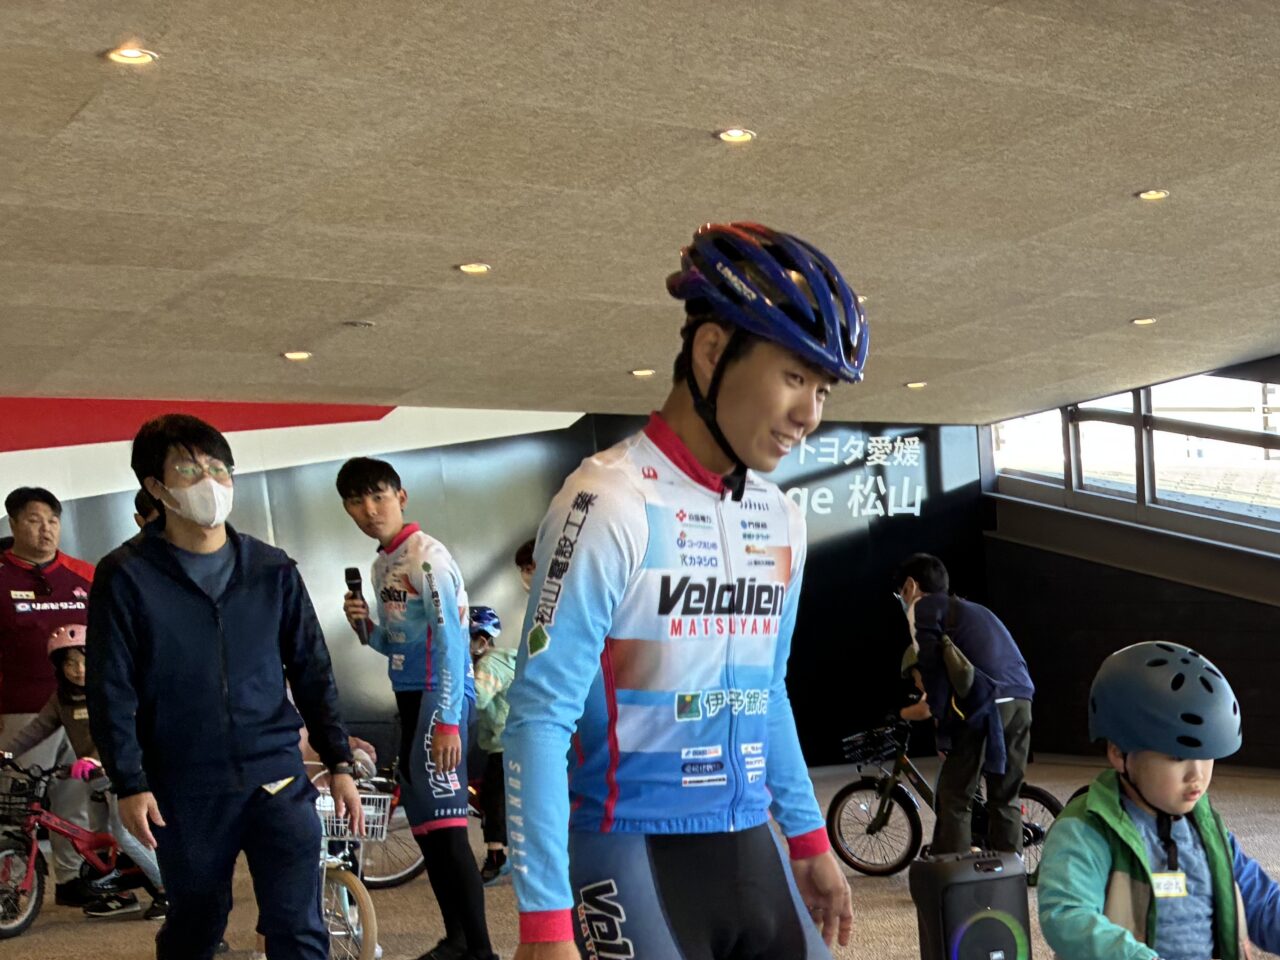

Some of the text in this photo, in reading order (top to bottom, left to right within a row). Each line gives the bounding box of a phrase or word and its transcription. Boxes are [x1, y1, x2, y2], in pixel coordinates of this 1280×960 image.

[799, 435, 921, 467] トヨタ愛媛
[847, 474, 924, 517] 松山
